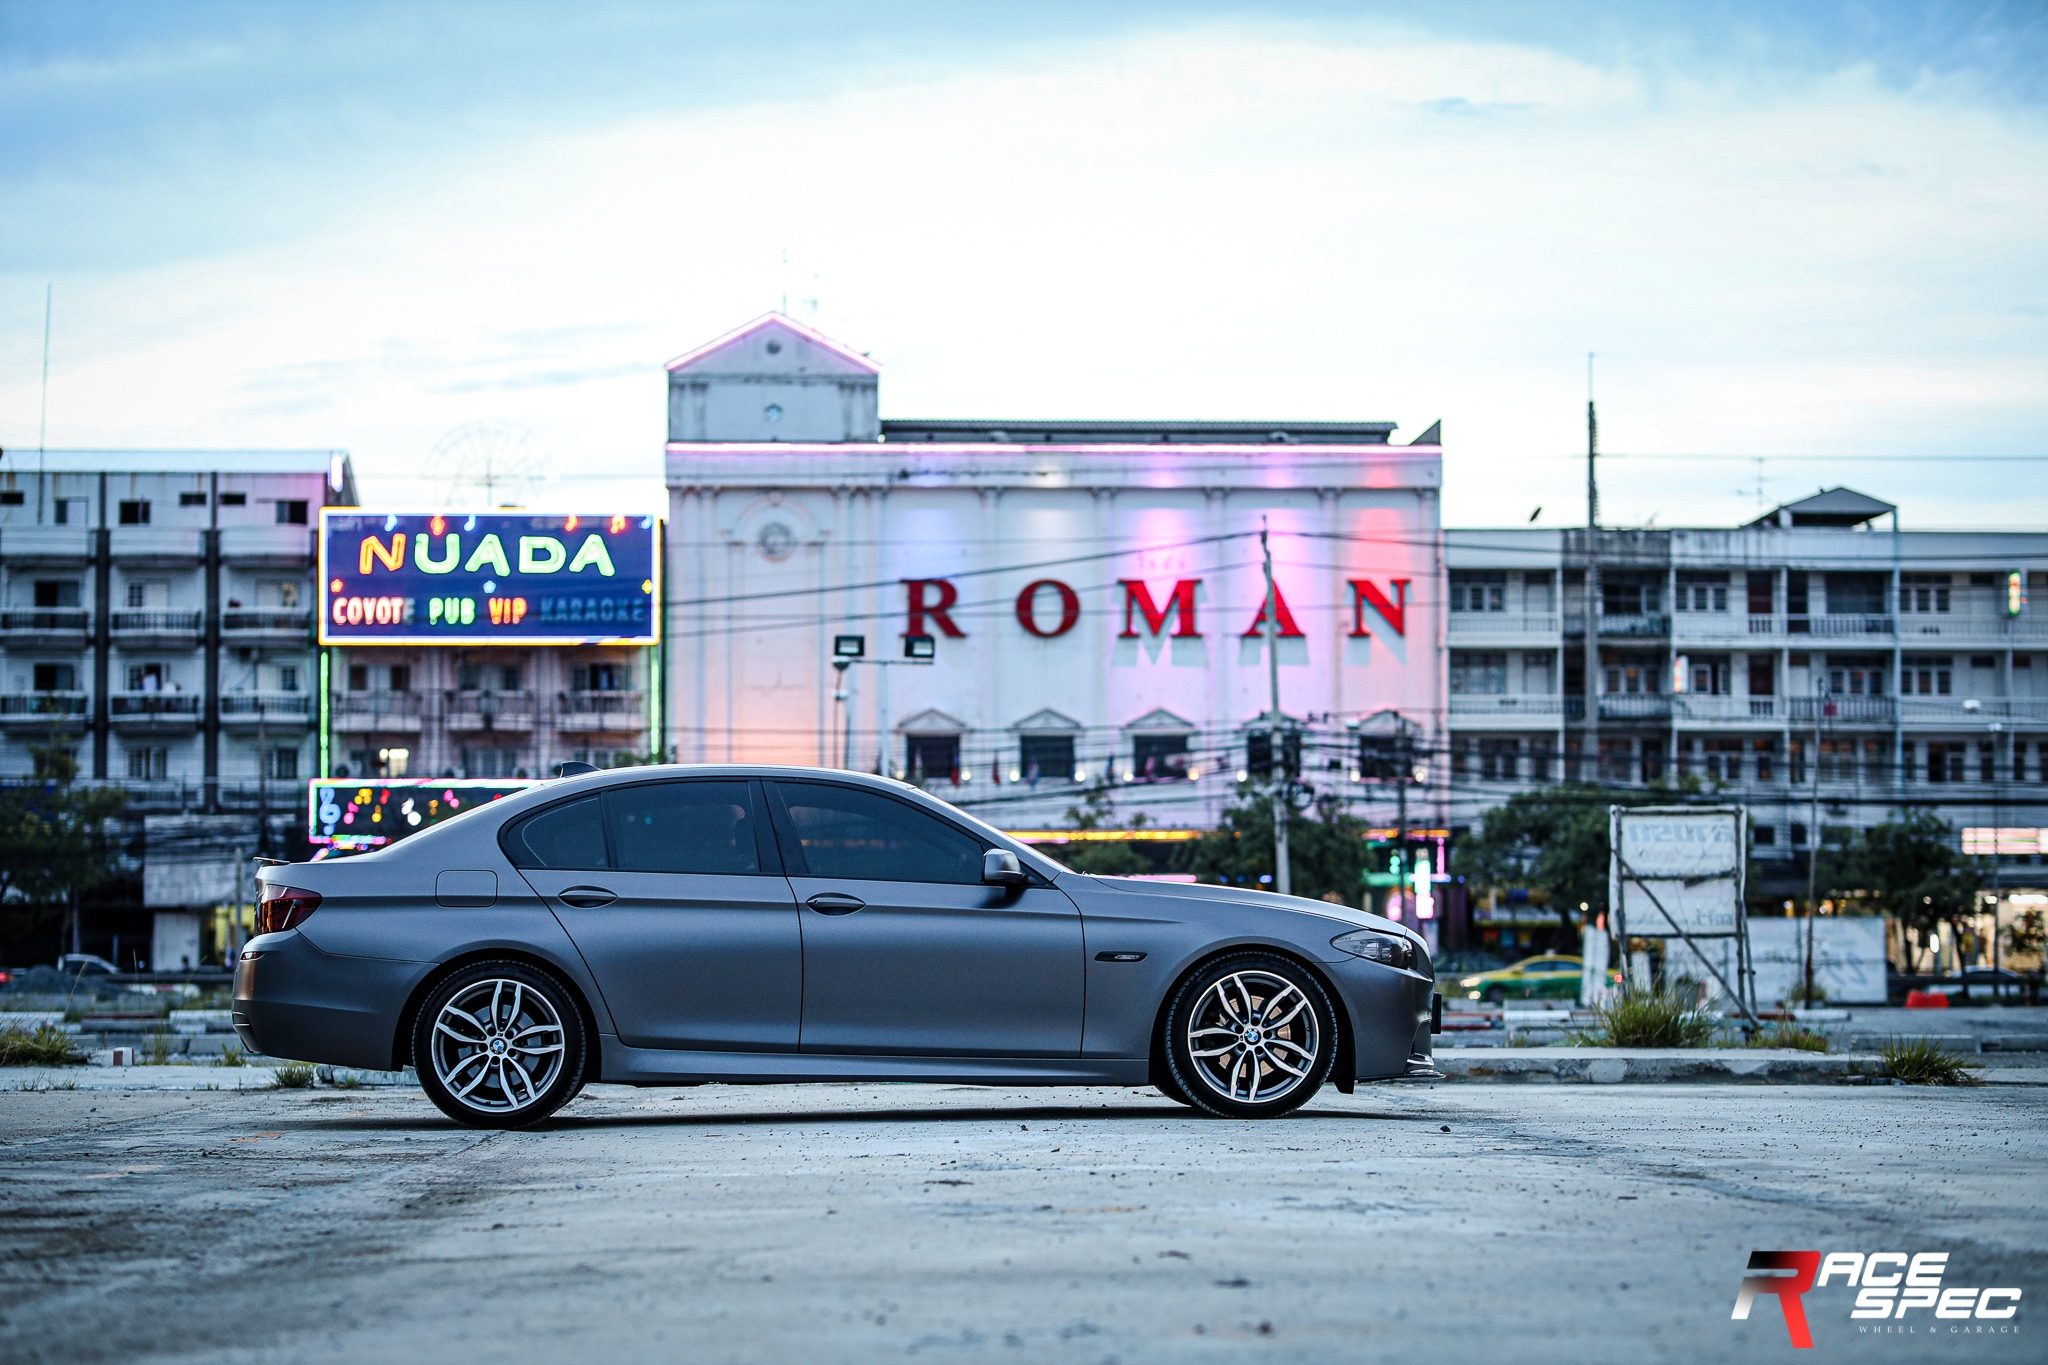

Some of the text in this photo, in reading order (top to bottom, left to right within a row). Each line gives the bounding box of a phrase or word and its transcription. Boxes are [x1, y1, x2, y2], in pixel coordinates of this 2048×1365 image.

[359, 533, 616, 577] NUADA
[333, 596, 645, 625] COYOTE PUB VIP KARAOKE
[900, 578, 1412, 638] ROMAN
